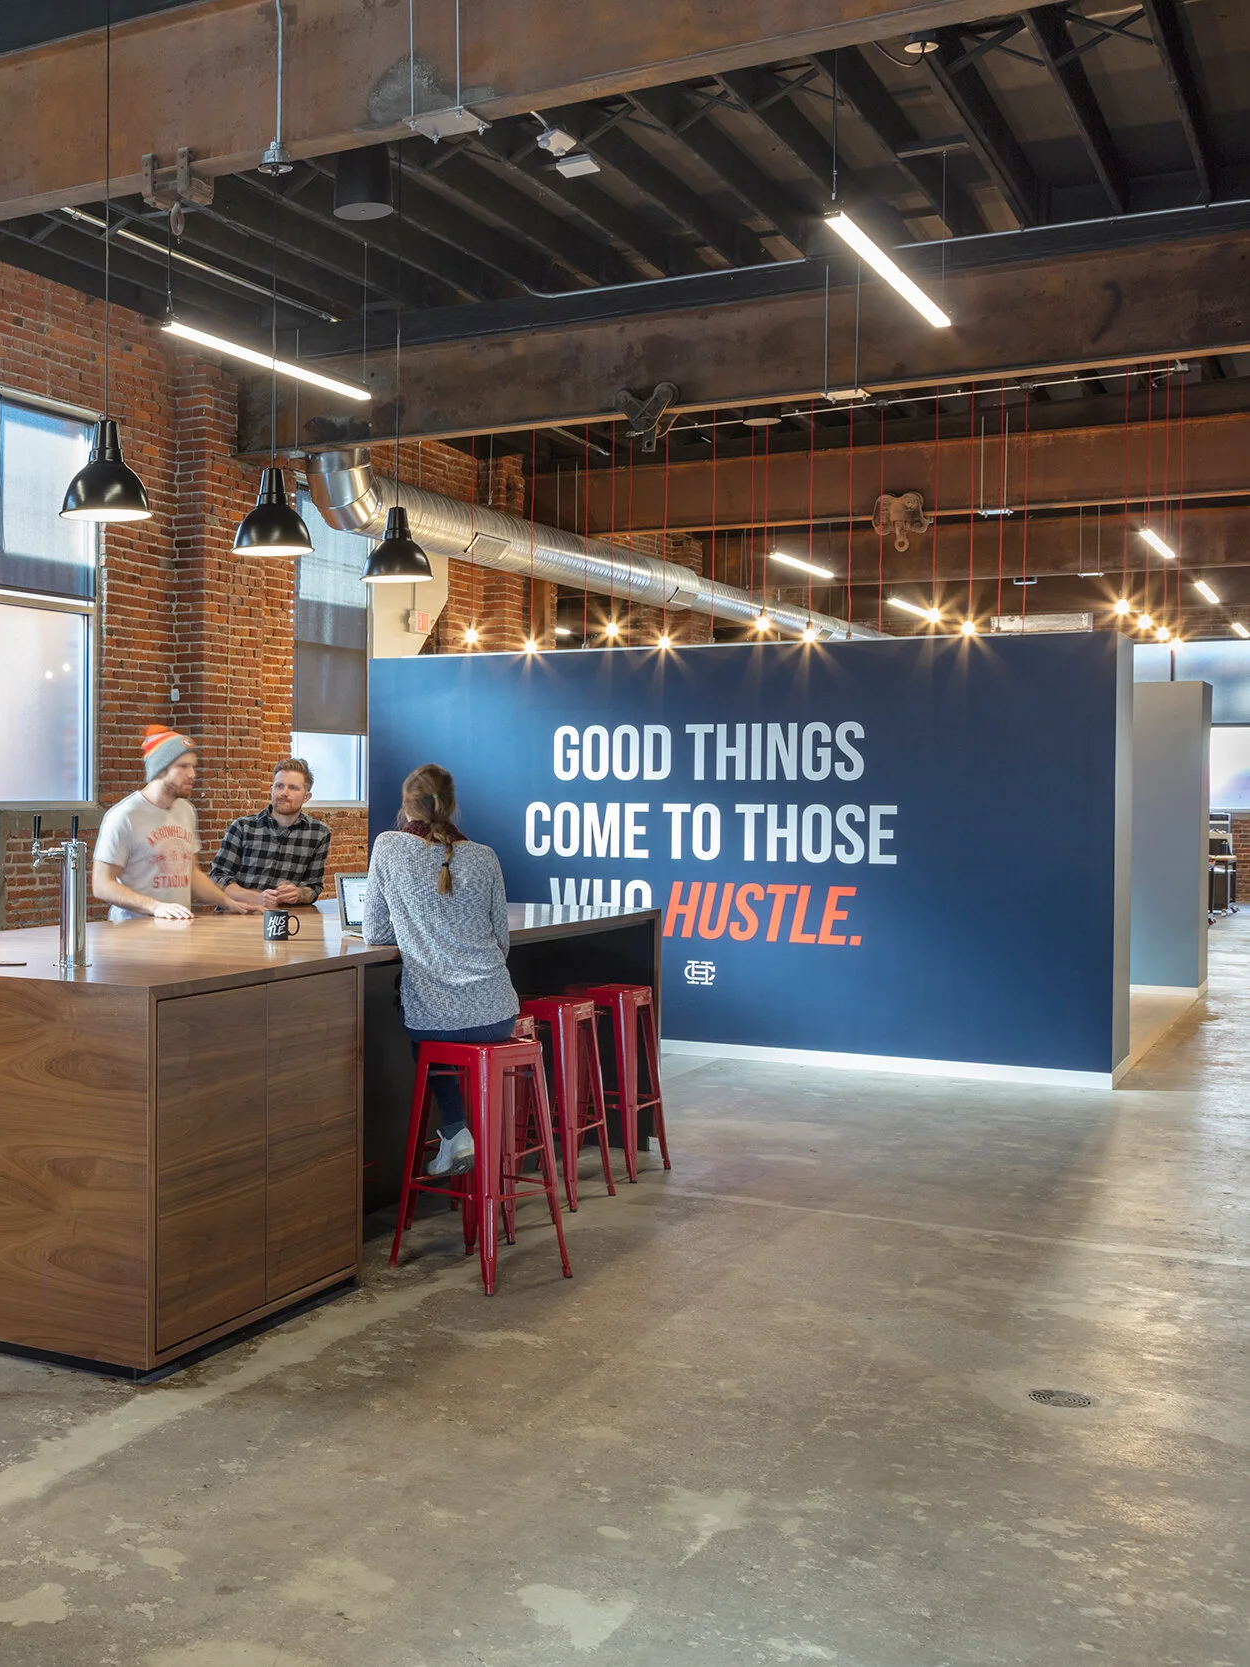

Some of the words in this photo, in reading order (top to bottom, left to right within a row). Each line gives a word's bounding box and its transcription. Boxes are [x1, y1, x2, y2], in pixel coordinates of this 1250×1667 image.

[552, 724, 672, 781] GOOD
[685, 721, 865, 782] THINGS
[525, 801, 649, 859] COME
[662, 803, 721, 861] TO
[735, 804, 898, 865] THOSE
[267, 925, 286, 937] TLE
[268, 915, 286, 926] HUS
[663, 880, 862, 946] HUSTLE.
